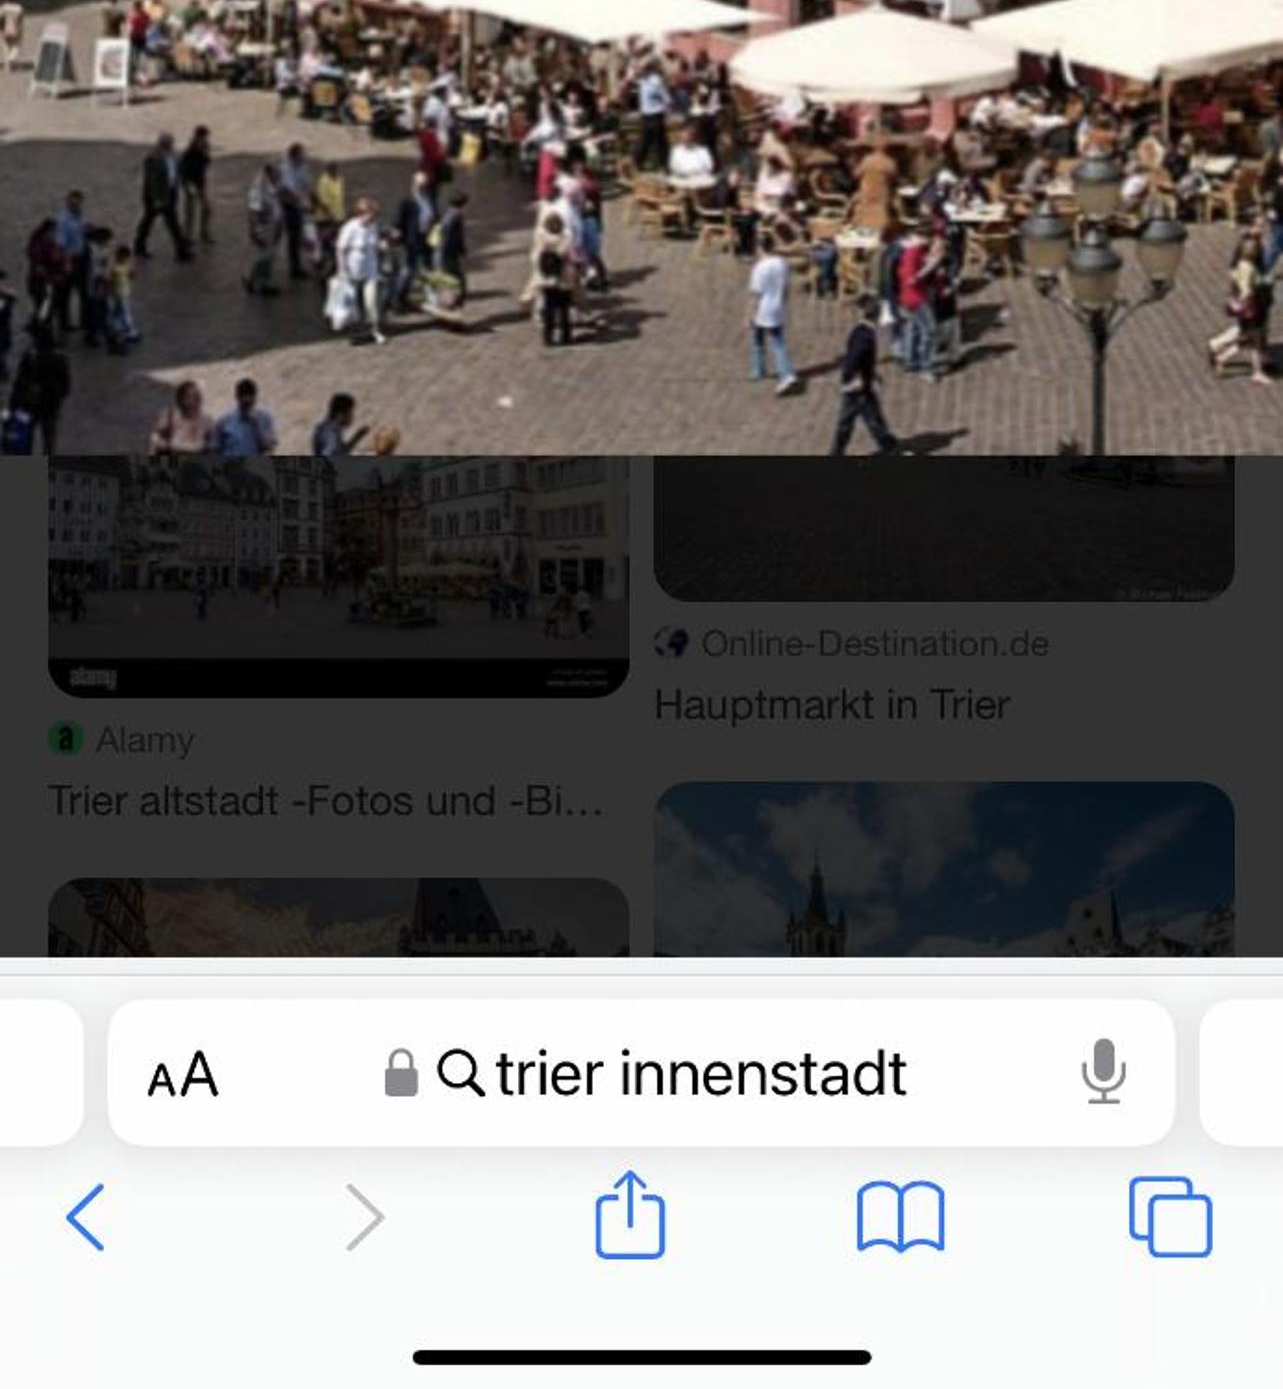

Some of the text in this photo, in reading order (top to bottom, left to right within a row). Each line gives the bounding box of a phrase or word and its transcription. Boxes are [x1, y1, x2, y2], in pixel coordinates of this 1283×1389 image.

[700, 627, 1051, 659] Online-Destination.de
[654, 687, 1012, 729] Hauptmarkt in Trier
[95, 724, 195, 761] Alamy
[46, 784, 129, 817] Trier
[139, 783, 280, 817] altstadt
[291, 784, 414, 817] -Fotos
[427, 784, 497, 817] und
[495, 1048, 908, 1097] trier innenstadt
